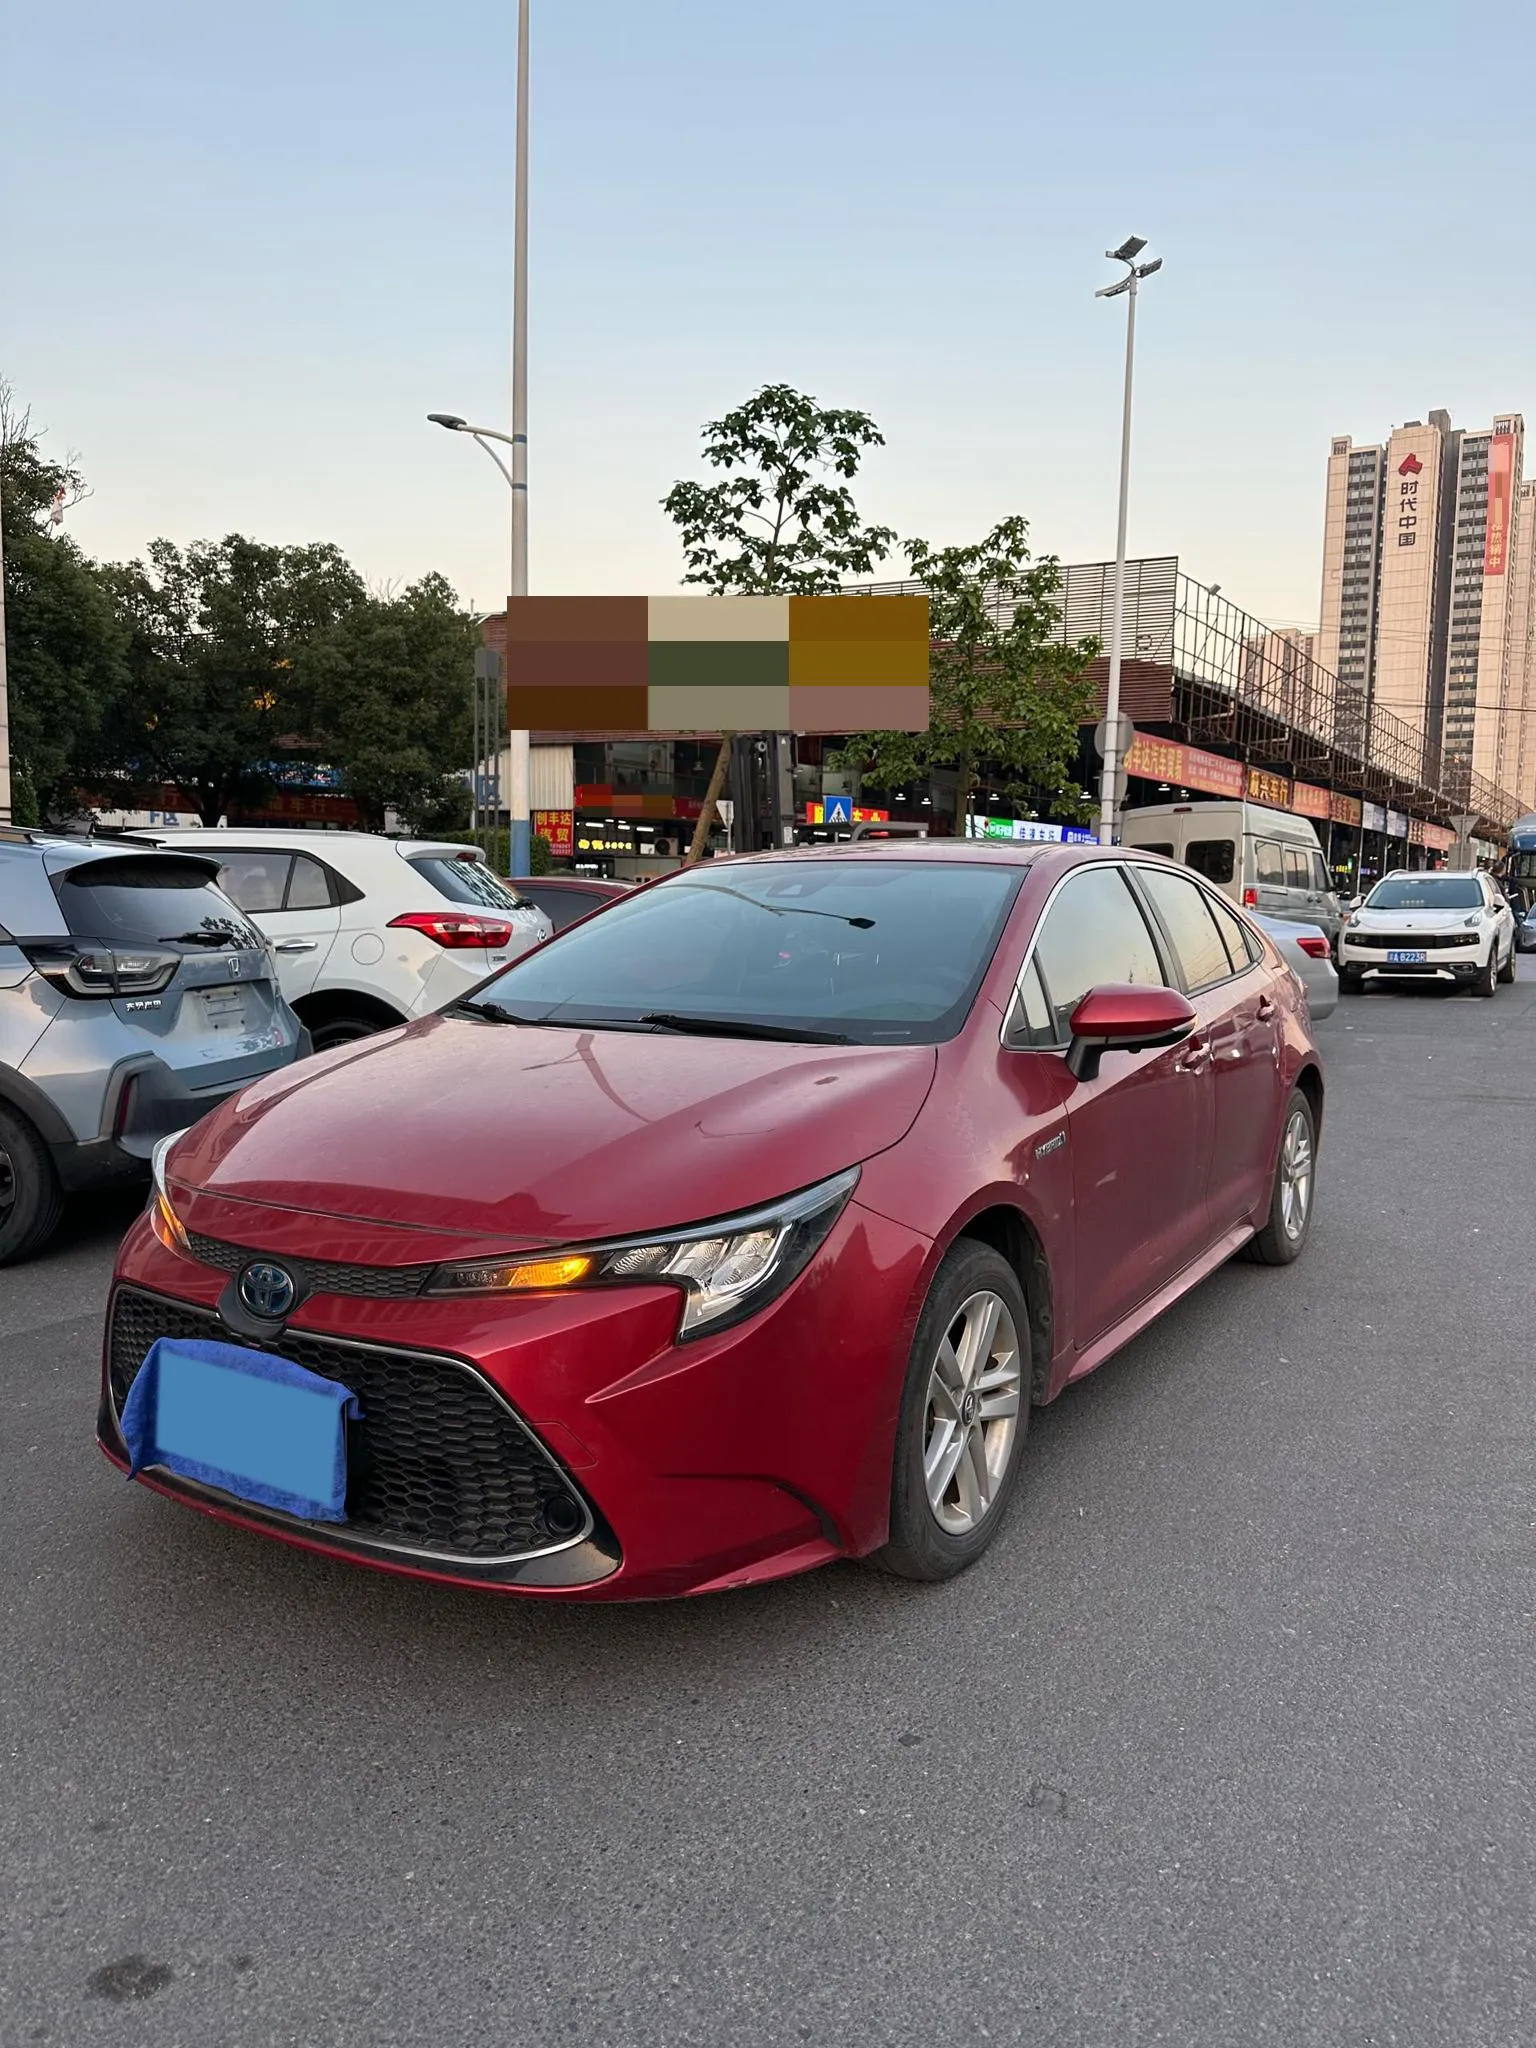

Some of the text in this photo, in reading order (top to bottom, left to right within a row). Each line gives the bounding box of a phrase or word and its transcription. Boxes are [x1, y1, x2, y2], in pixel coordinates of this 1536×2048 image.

[1399, 480, 1419, 547] 时代中国
[537, 811, 572, 826] 创丰达
